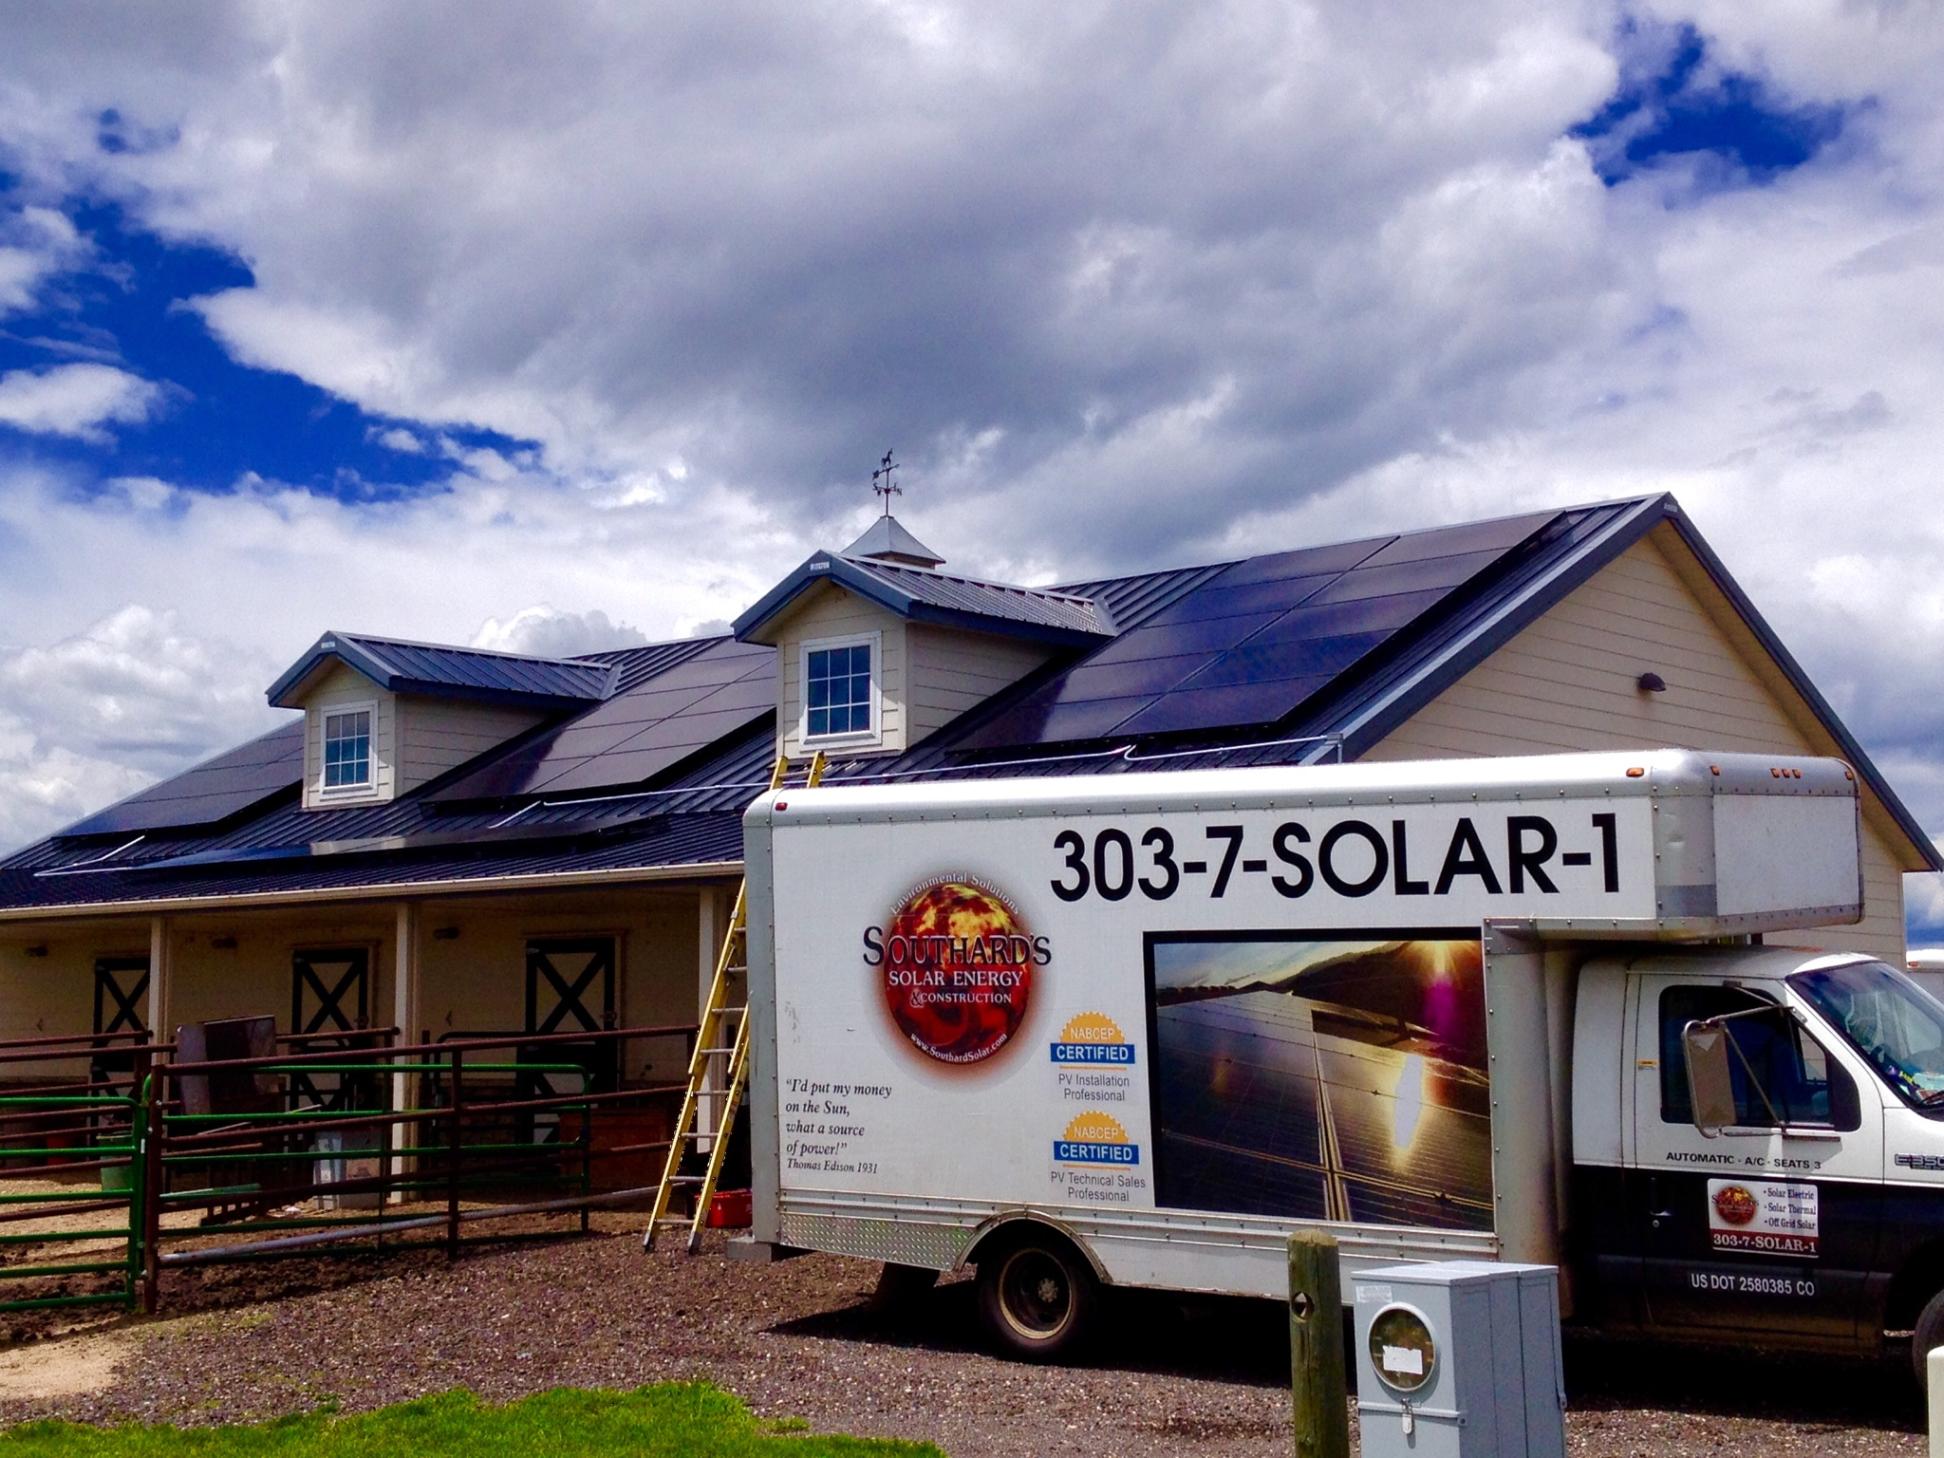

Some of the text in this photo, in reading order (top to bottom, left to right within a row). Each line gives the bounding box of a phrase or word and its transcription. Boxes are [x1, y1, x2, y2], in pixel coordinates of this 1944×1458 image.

[1050, 813, 1620, 902] 303-7-SOLAR-1
[890, 872, 1019, 915] Environmental Solutions
[888, 970, 1023, 987] SOLAR ENERGY
[1070, 1027, 1116, 1040] NABCEP
[1056, 1045, 1129, 1061] CERTIFIED
[1058, 1073, 1130, 1087] PV Installation
[811, 1082, 830, 1096] put
[833, 1084, 851, 1097] my
[854, 1085, 892, 1099] money
[1064, 1088, 1126, 1101] Professional
[785, 1100, 850, 1117] on the Sun,
[786, 1120, 865, 1136] what a source
[1074, 1126, 1119, 1139] NABCEP
[786, 1140, 799, 1156] of
[1060, 1144, 1133, 1161] CERTIFIED
[787, 1158, 878, 1174] Thomas Edison 1931
[1665, 1151, 1822, 1170] AUTOMATIC A/C SEATS 3
[1050, 1171, 1146, 1189] PV Technical Sales
[1068, 1187, 1130, 1202] Professional
[1767, 1187, 1815, 1201] Solar Electric
[1768, 1202, 1817, 1216] Solar Thermal
[1768, 1217, 1816, 1231] Off Grid Solar
[1713, 1233, 1817, 1254] 303-7-SOLAR-1
[1691, 1273, 1816, 1297] US DOT 2580385 CO
